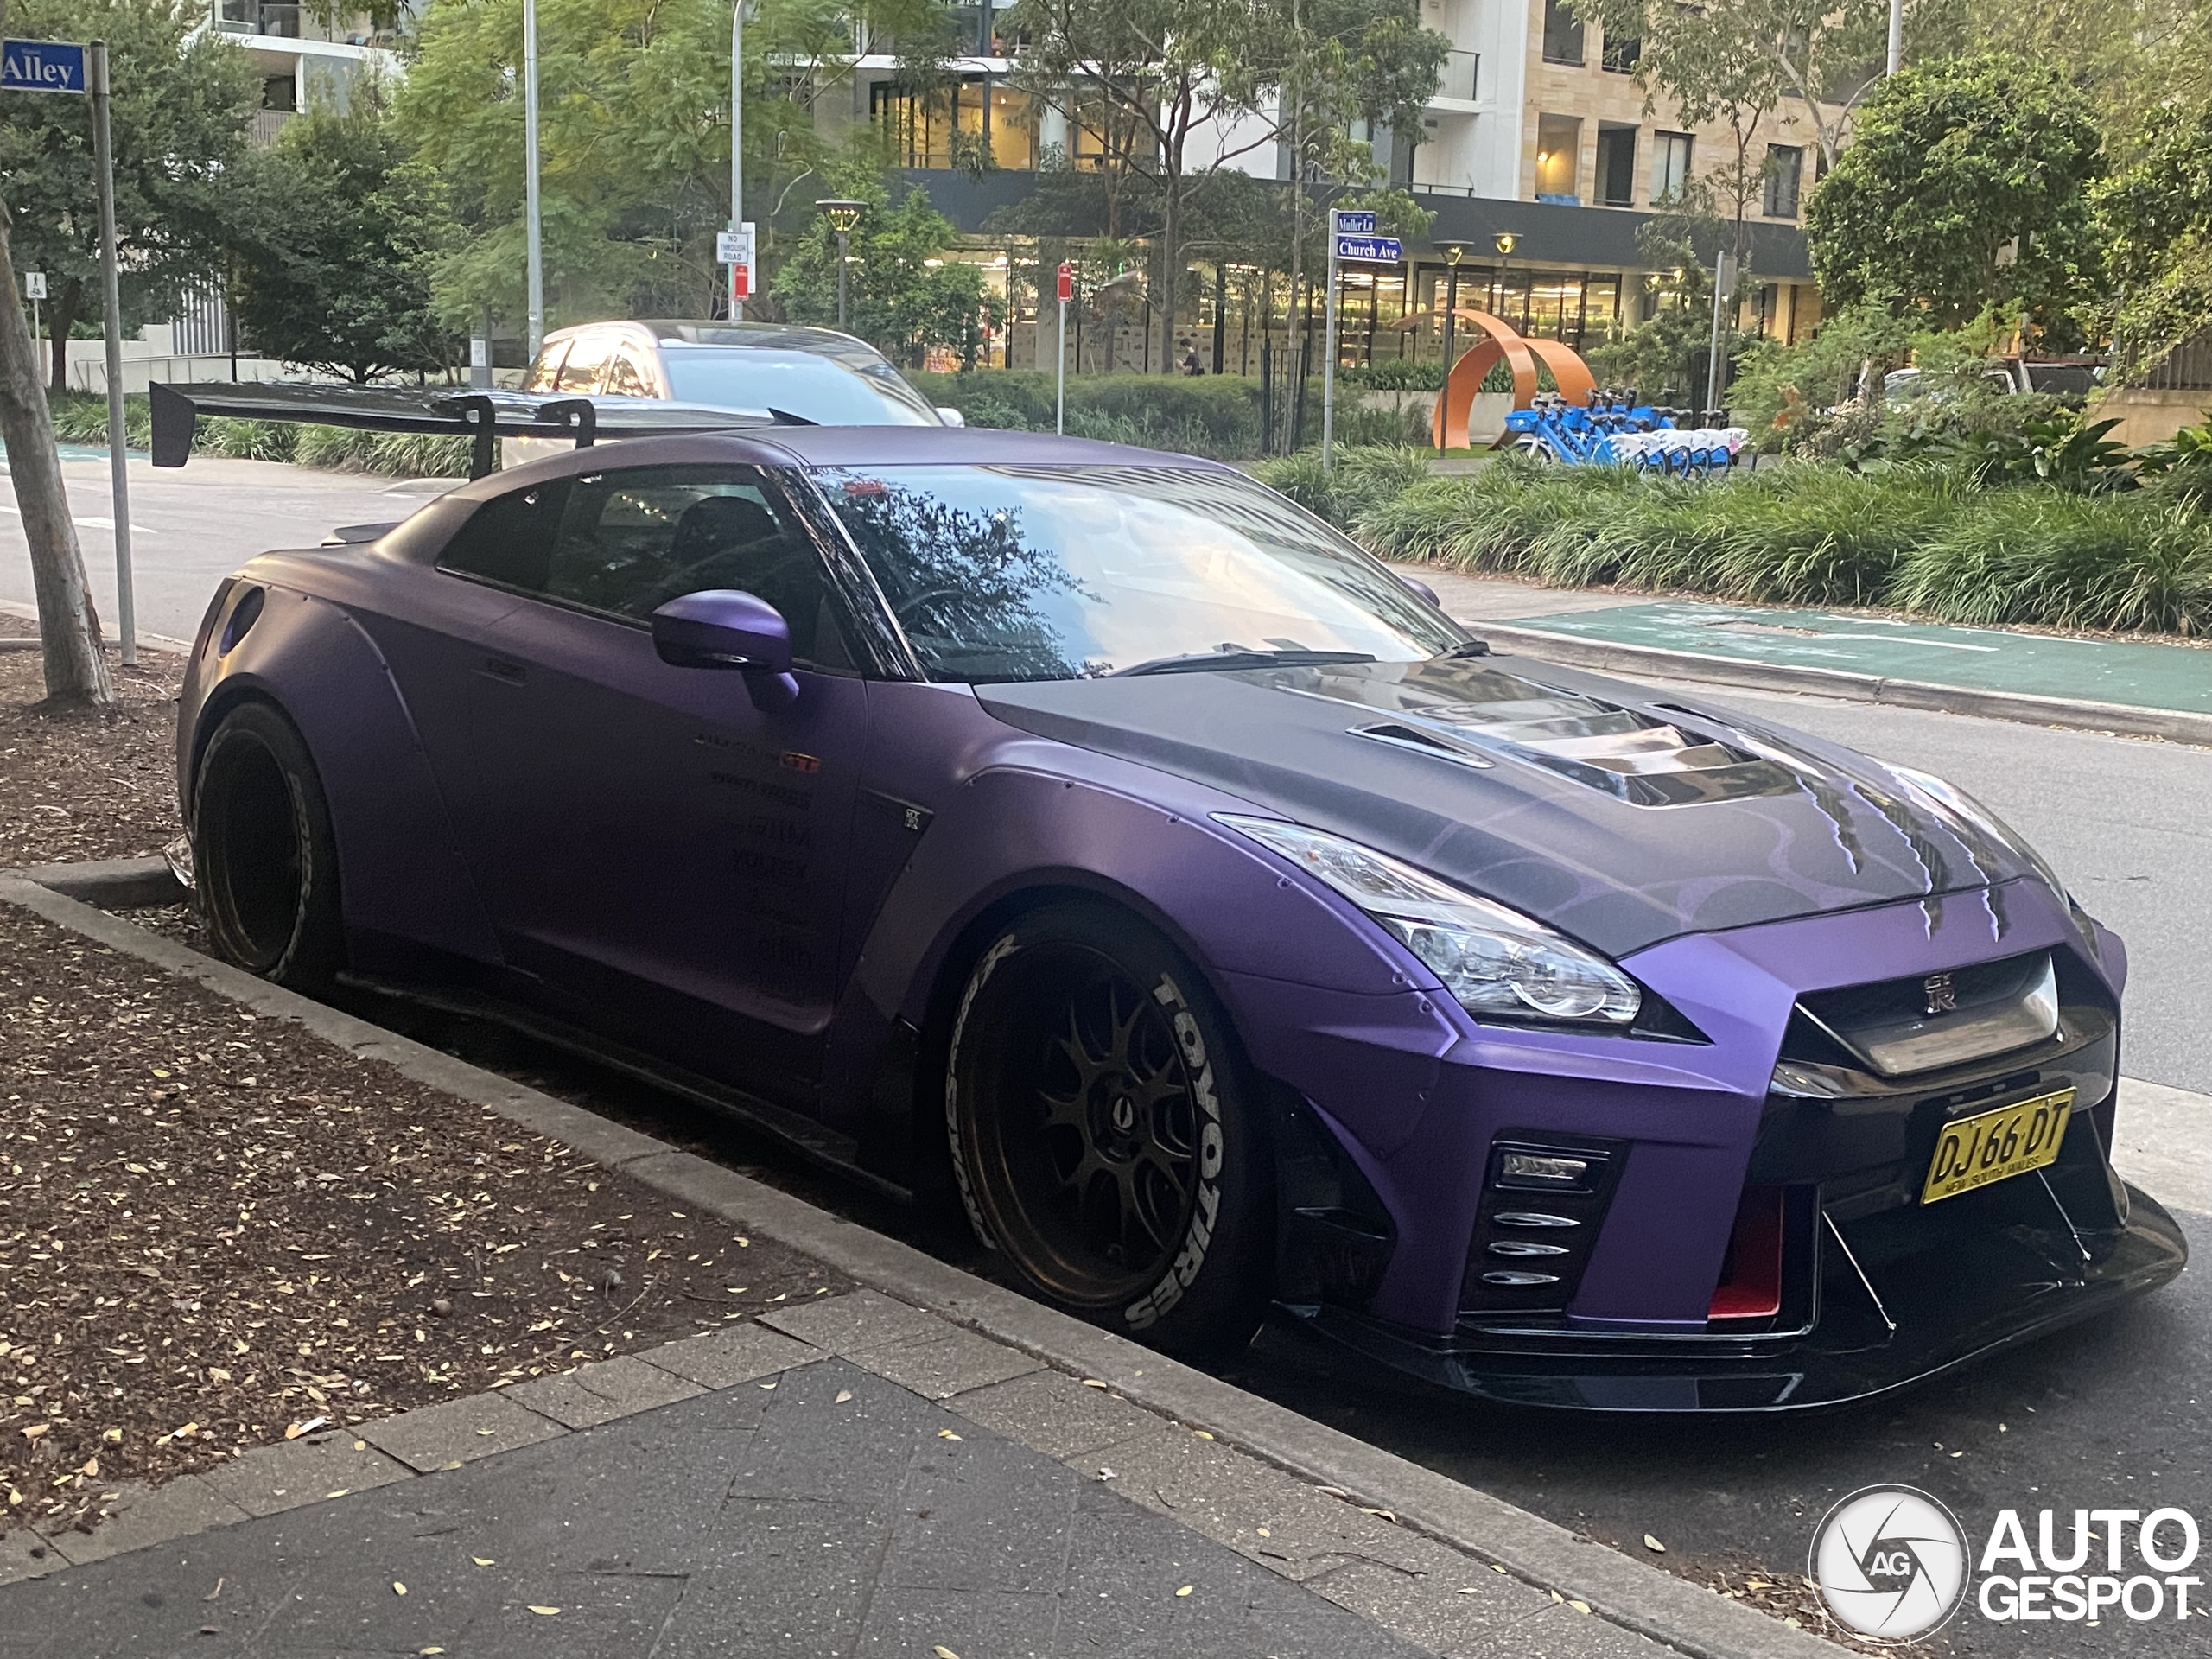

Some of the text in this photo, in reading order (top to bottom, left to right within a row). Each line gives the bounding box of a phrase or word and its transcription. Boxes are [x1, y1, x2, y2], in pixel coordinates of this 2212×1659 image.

[3, 55, 73, 89] Alley
[1363, 219, 1373, 232] Ln
[1339, 241, 1398, 259] Church Ave
[1946, 1155, 2040, 1193] NEW SOUTH WALES
